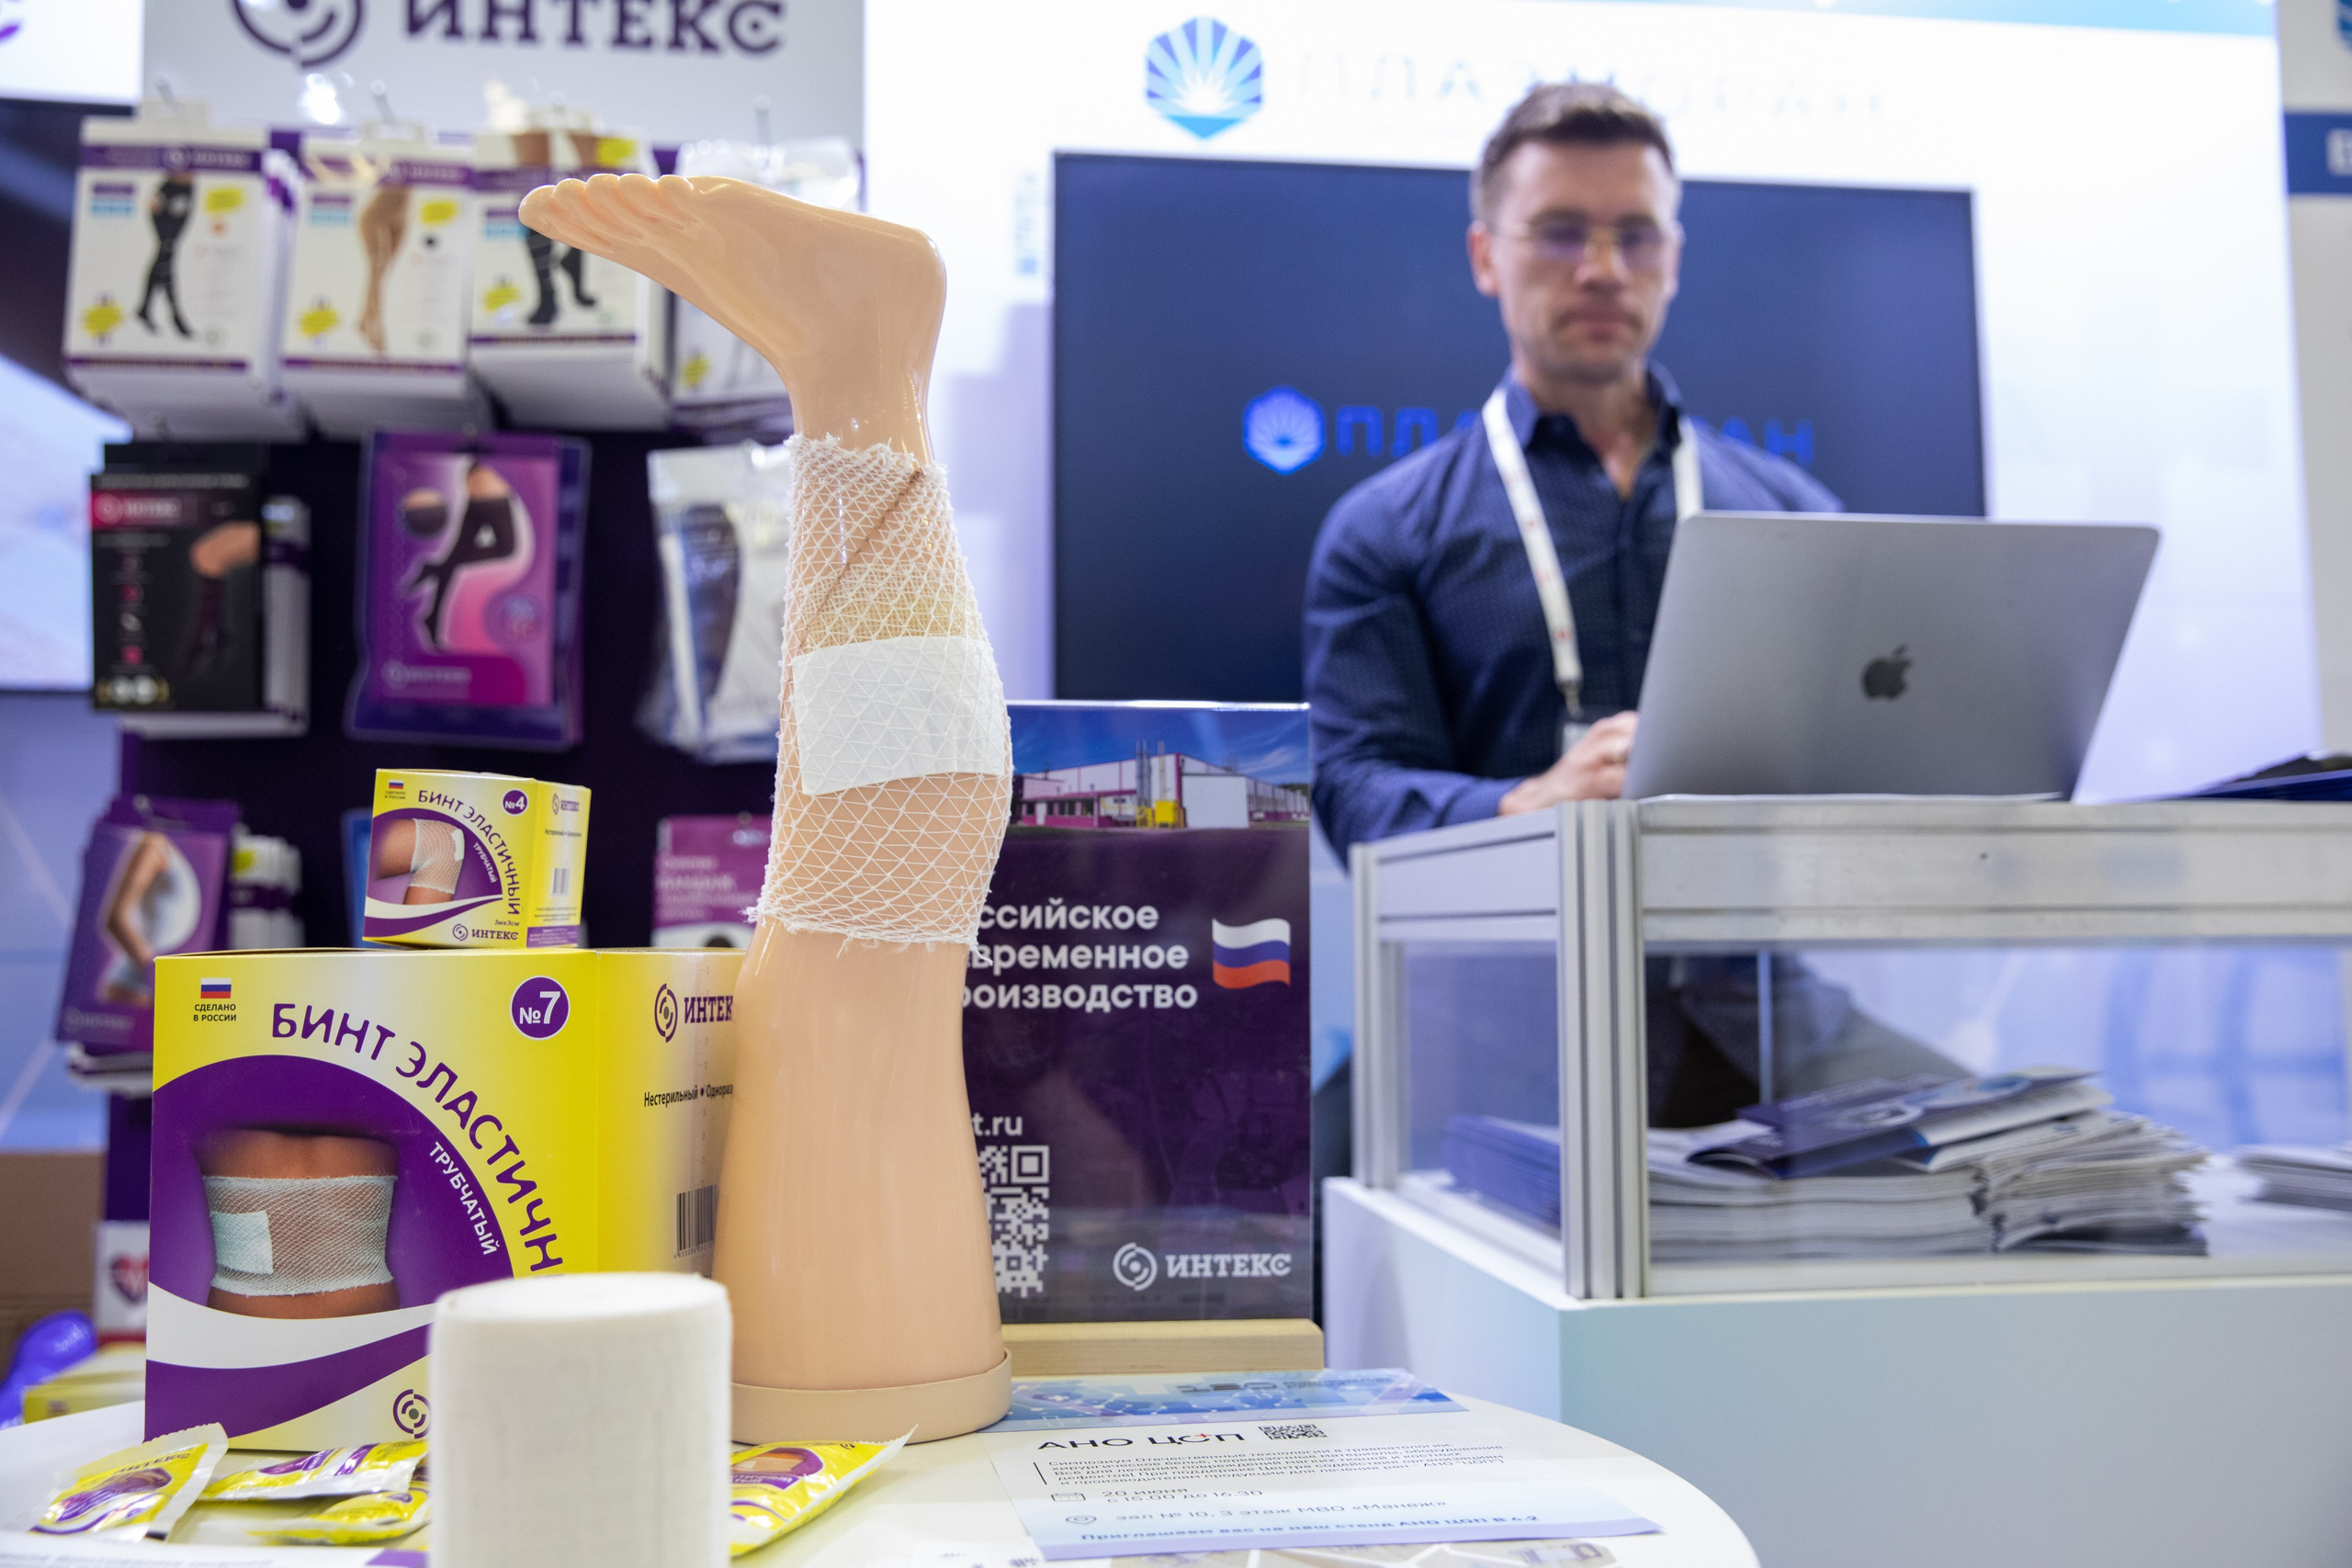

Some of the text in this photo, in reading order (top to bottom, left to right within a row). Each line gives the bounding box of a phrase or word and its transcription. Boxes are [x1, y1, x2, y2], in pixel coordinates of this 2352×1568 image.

[504, 795, 526, 810] №4
[418, 789, 521, 915] БИНТ ЭЛАСТИЧНЫЙ
[472, 841, 497, 884] ТРУБЧАТЫЙ
[978, 897, 1160, 931] ссийское
[471, 929, 519, 941] ИНТЕКС
[970, 943, 1190, 976] временное
[194, 1002, 237, 1013] СДЕЛАНО
[518, 990, 562, 1027] №7
[684, 994, 734, 1025] ИНТЕК
[963, 983, 1199, 1014] оизводство
[193, 1013, 237, 1022] В РОССИИ
[643, 1082, 734, 1108] Нестерильный Однораз
[271, 1001, 564, 1279] БИНТ ЭЛАСТИЧН
[428, 1140, 500, 1257] ТРУБЧАТЫЙ
[1165, 1252, 1293, 1279] ИНТЕКС
[1037, 1438, 1134, 1450] АНО
[1351, 1502, 1446, 1510] «Манеж»
[1080, 1529, 1213, 1540] Приглашаем
